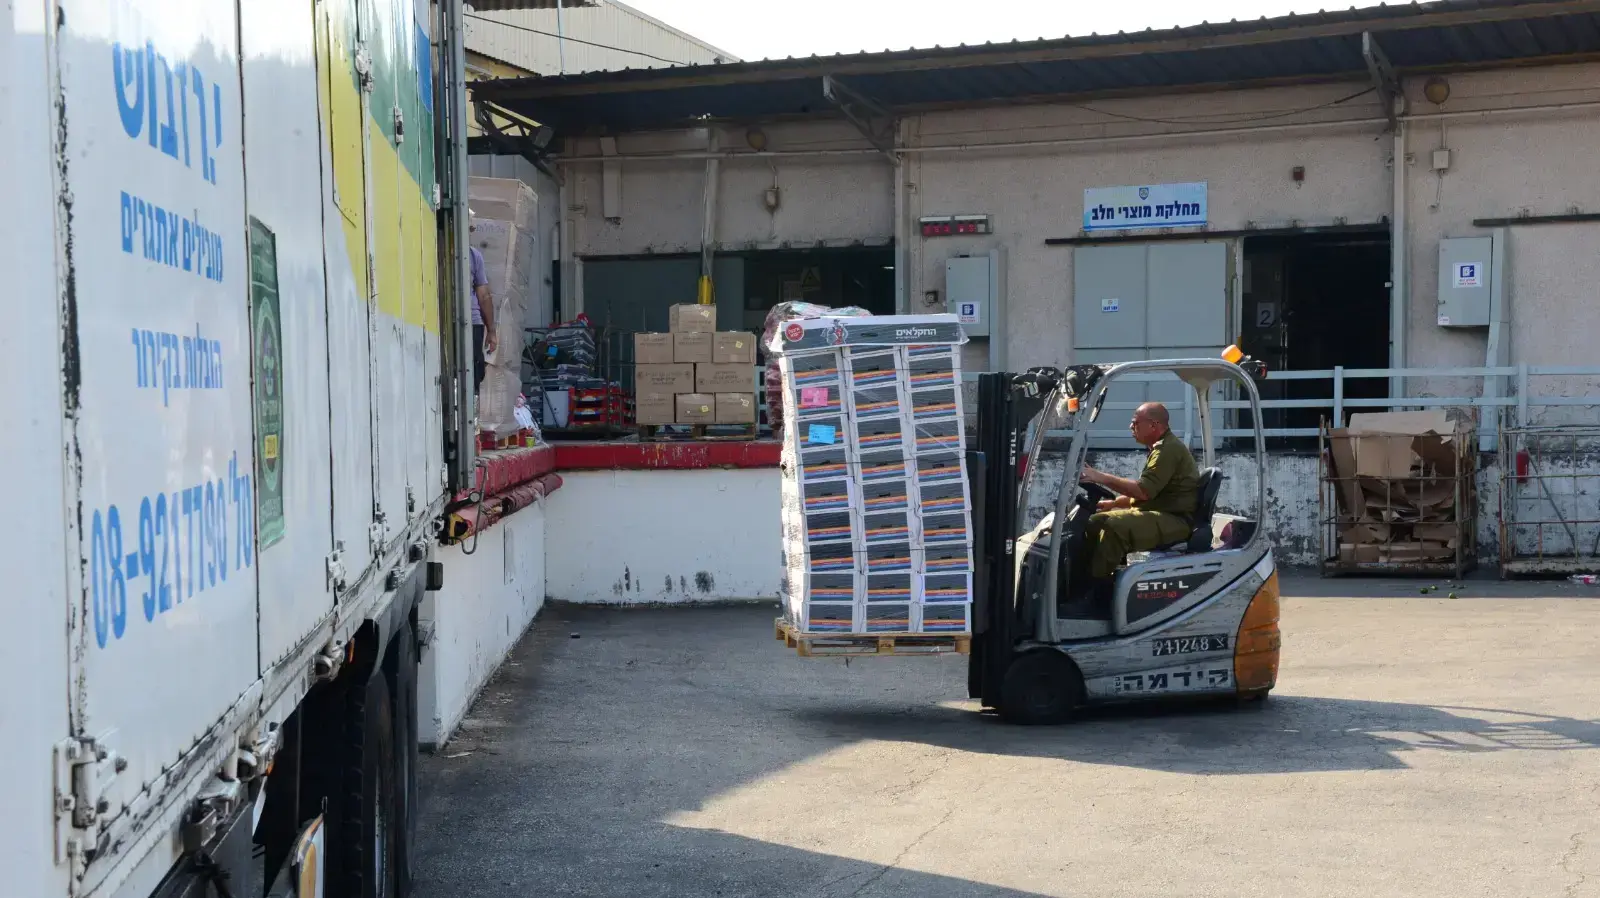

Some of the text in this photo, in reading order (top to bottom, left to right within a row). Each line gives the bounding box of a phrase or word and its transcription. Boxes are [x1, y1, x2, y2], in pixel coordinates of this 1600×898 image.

[1091, 200, 1200, 221] מחלקת מוצרי חלב
[120, 190, 178, 268] אתגרים
[182, 208, 223, 284] מובילים
[1260, 309, 1271, 325] 2
[896, 327, 937, 338] החקלאים
[131, 322, 223, 407] הובלות בקירור
[91, 478, 227, 649] 08-9217790
[1137, 580, 1189, 591] STIL
[1123, 669, 1228, 691] קידמה
